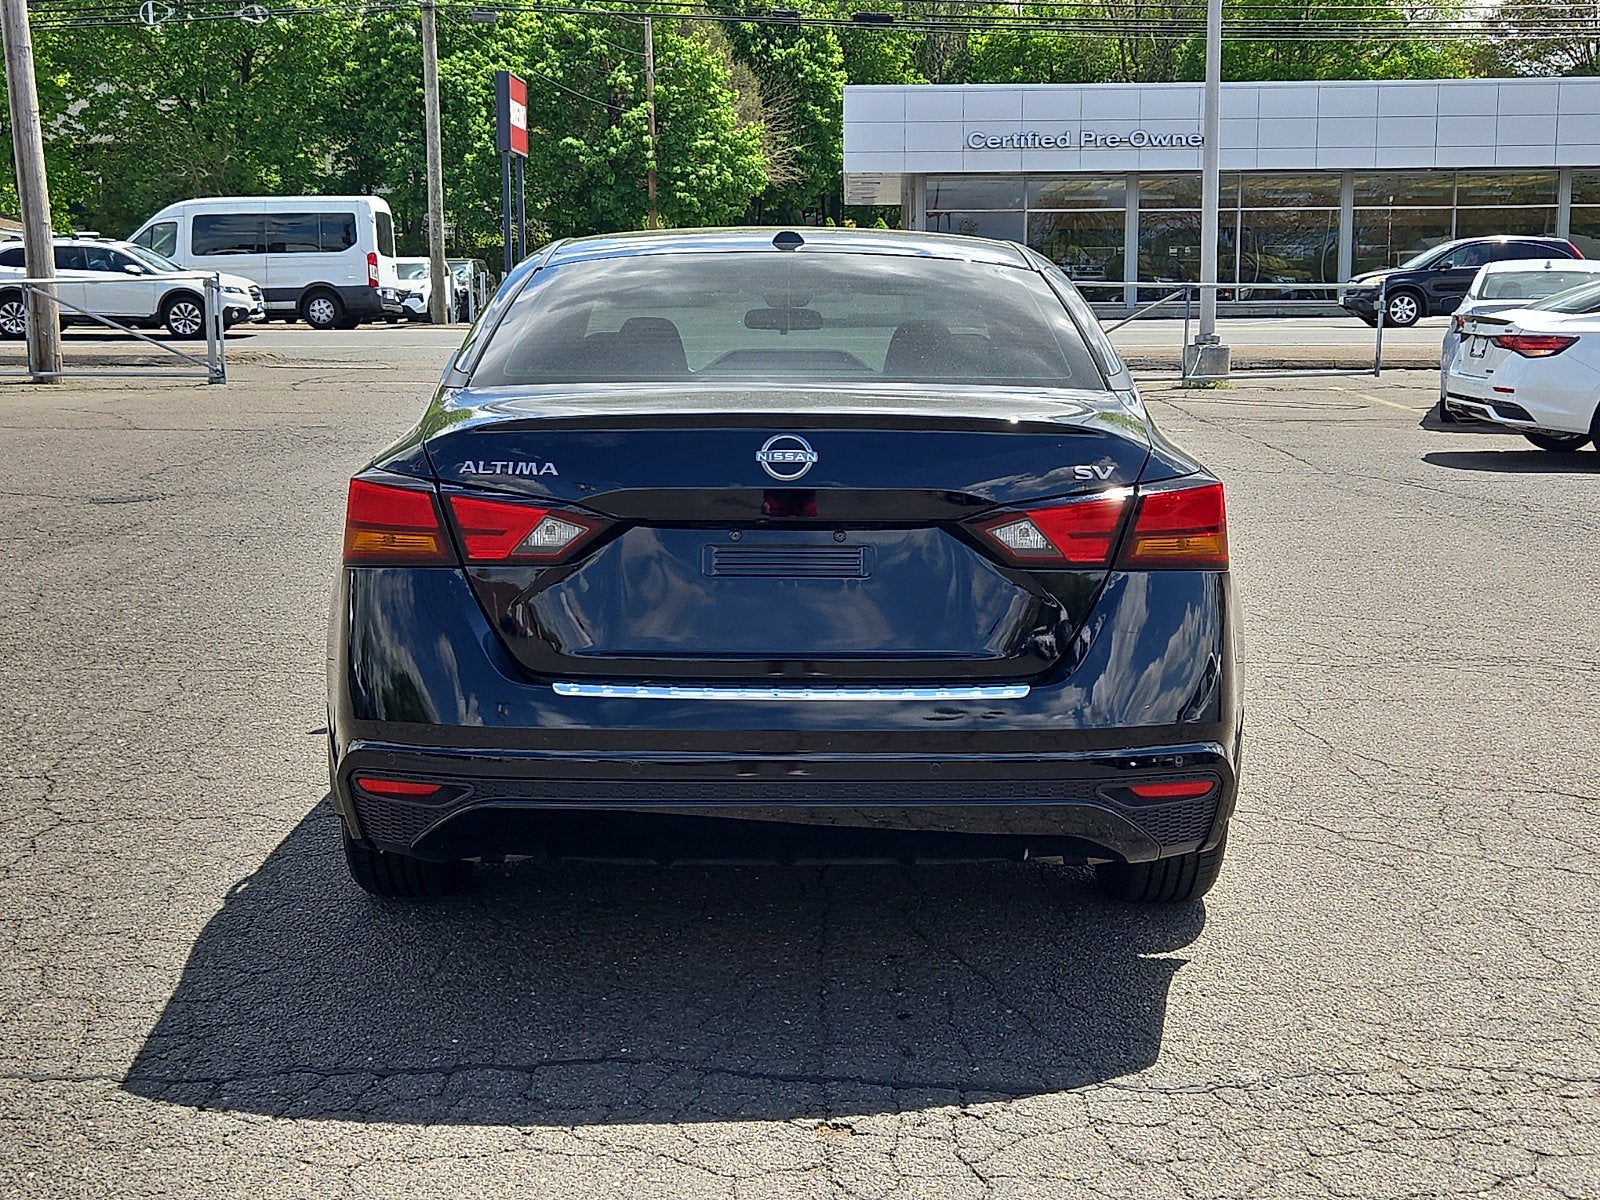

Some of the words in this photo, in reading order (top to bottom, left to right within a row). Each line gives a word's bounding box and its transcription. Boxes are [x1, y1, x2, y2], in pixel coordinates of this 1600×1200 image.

[967, 130, 1071, 149] Certified
[1080, 130, 1204, 148] Pre-Owne
[757, 451, 817, 461] NISSAN
[459, 460, 559, 476] ALTIMA
[1074, 465, 1115, 480] SV
